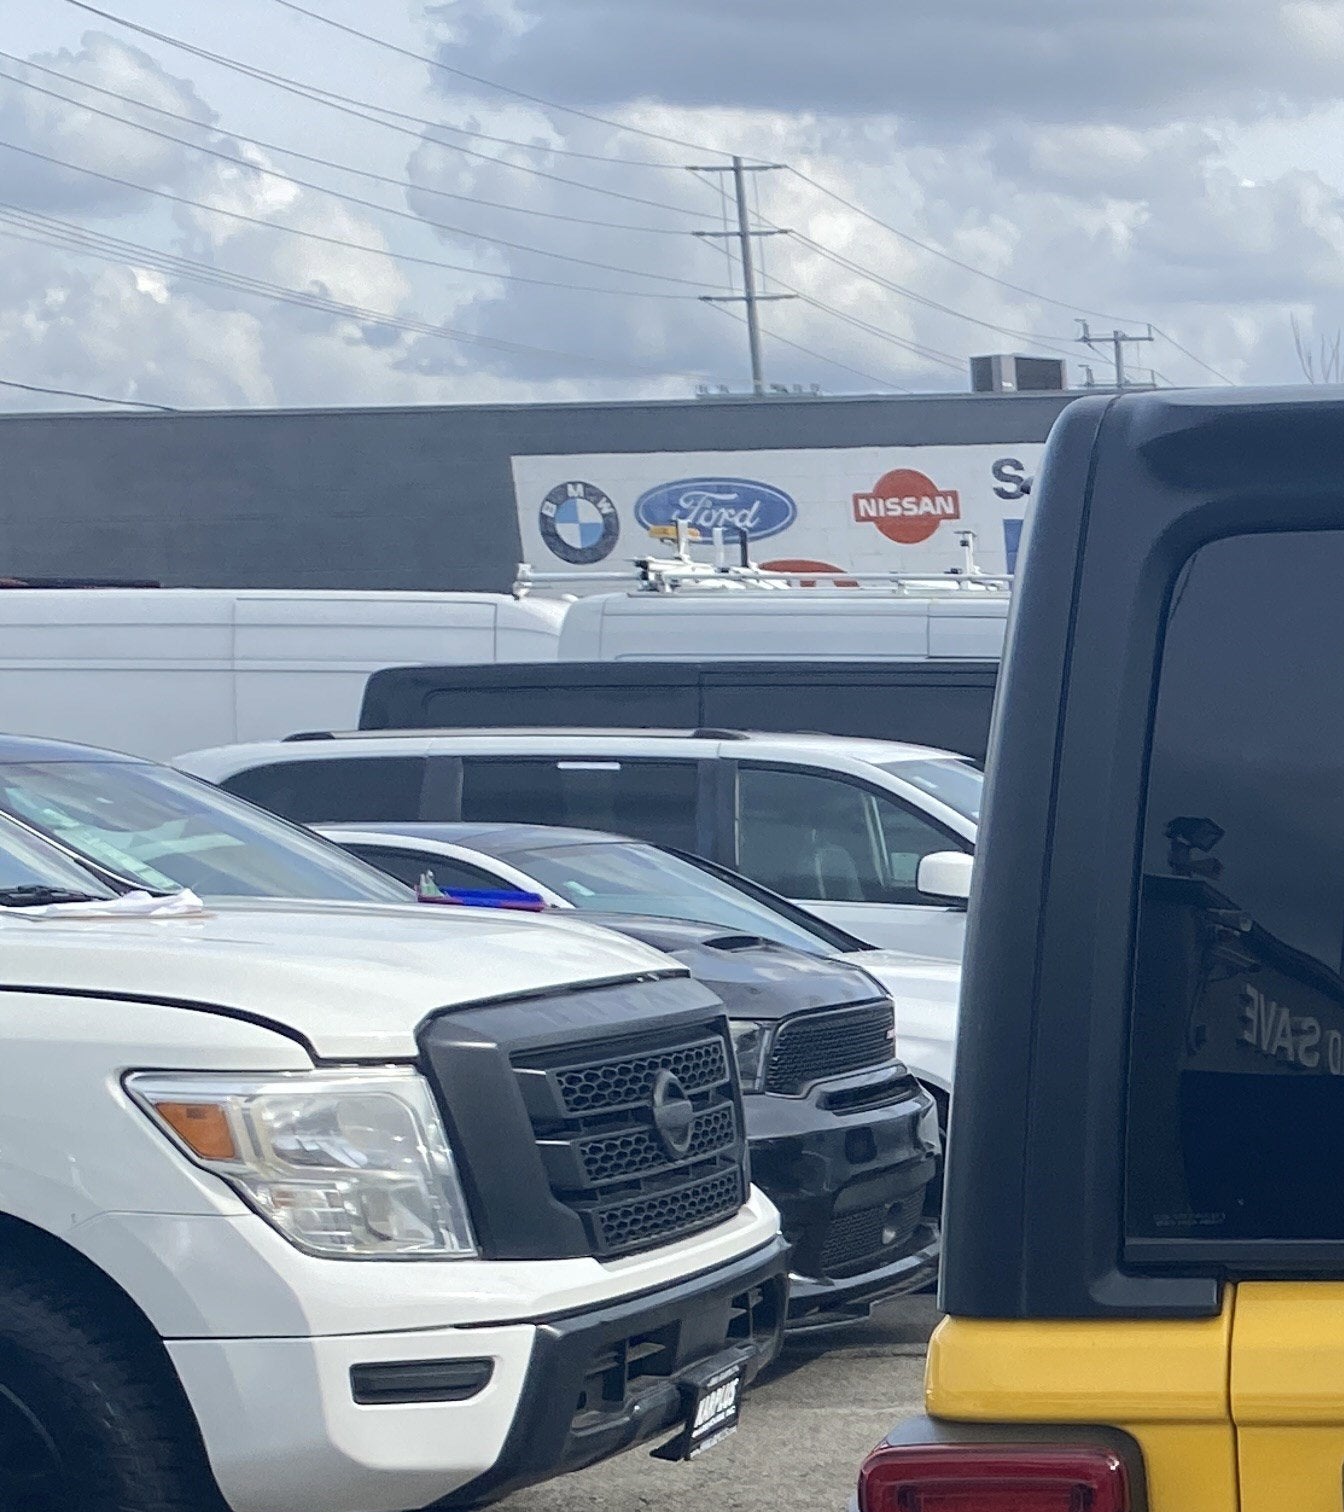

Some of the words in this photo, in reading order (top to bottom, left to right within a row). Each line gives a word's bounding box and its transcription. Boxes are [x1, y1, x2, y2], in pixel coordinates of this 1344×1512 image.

[541, 483, 614, 518] BMW
[675, 489, 761, 528] Ford
[857, 493, 957, 518] NISSAN
